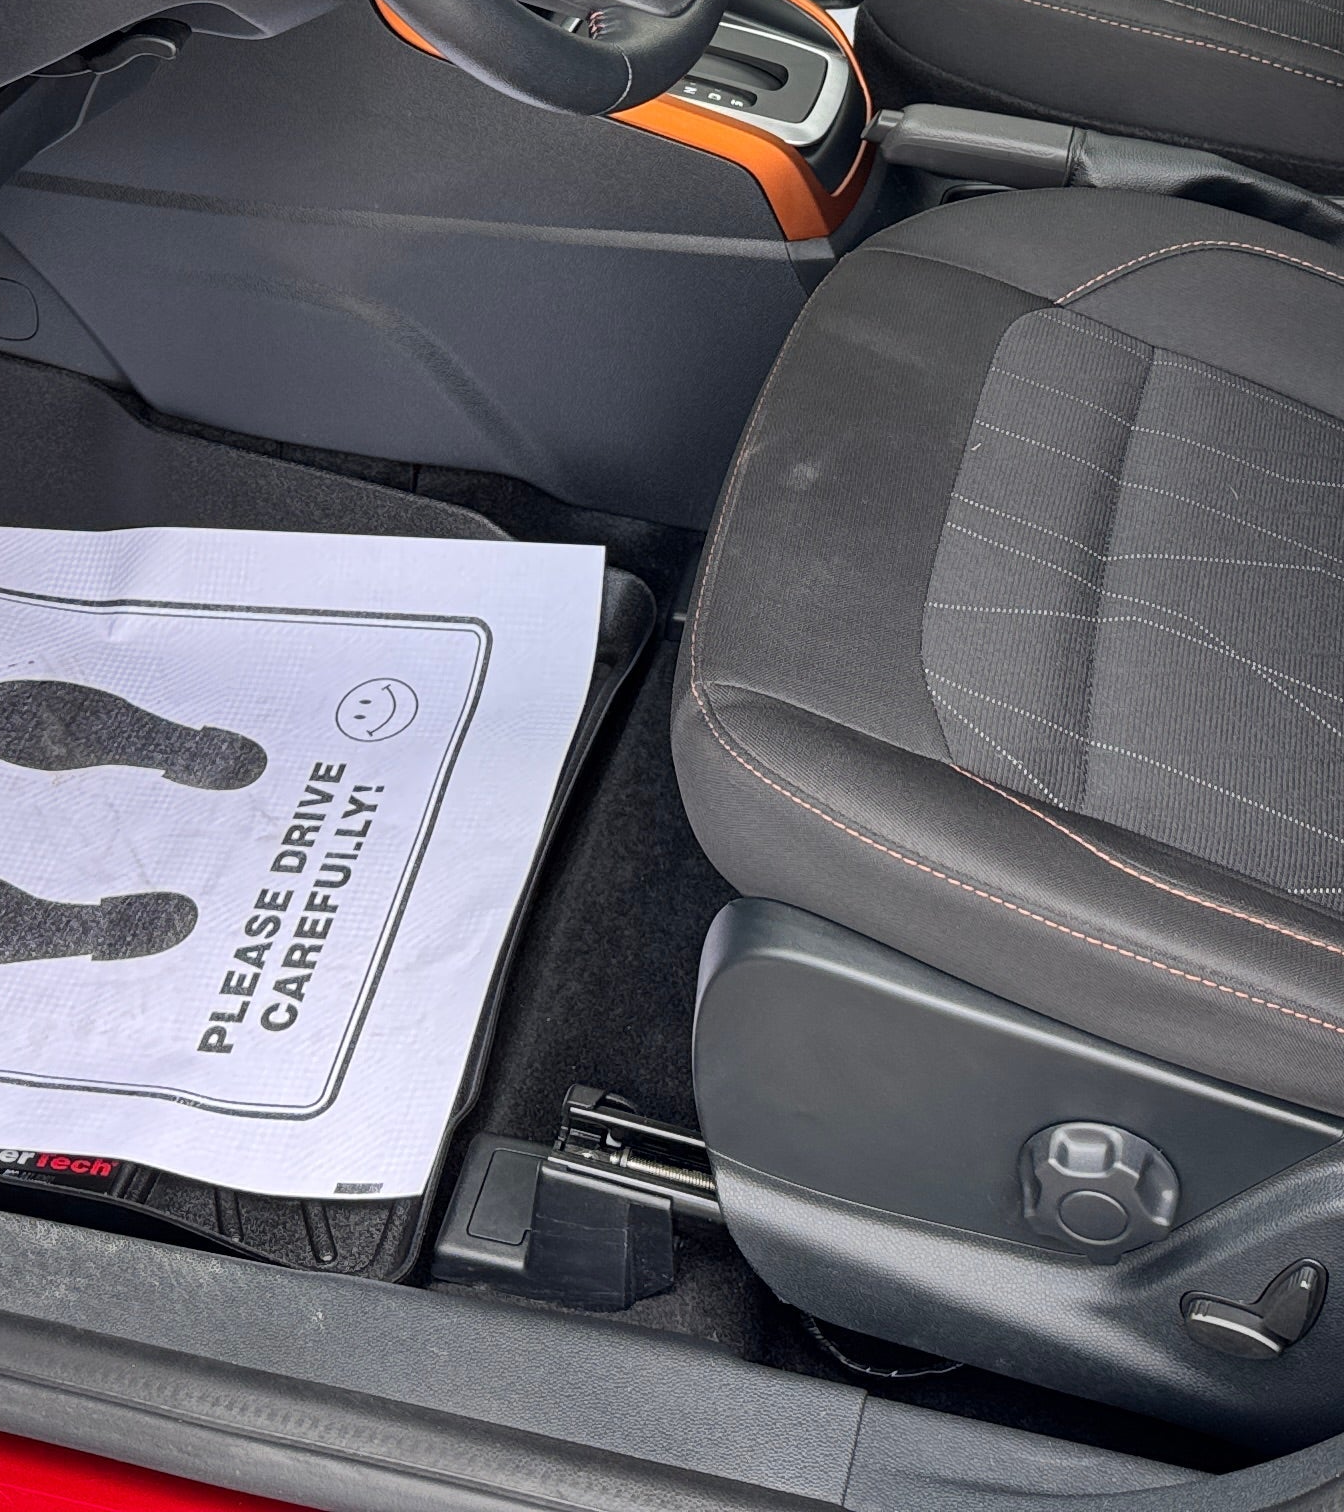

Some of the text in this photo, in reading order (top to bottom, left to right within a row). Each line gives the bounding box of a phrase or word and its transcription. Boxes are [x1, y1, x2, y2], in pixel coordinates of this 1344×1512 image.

[197, 761, 347, 1054] PLEASE DRIVE
[260, 785, 385, 1032] CAREFULLY!
